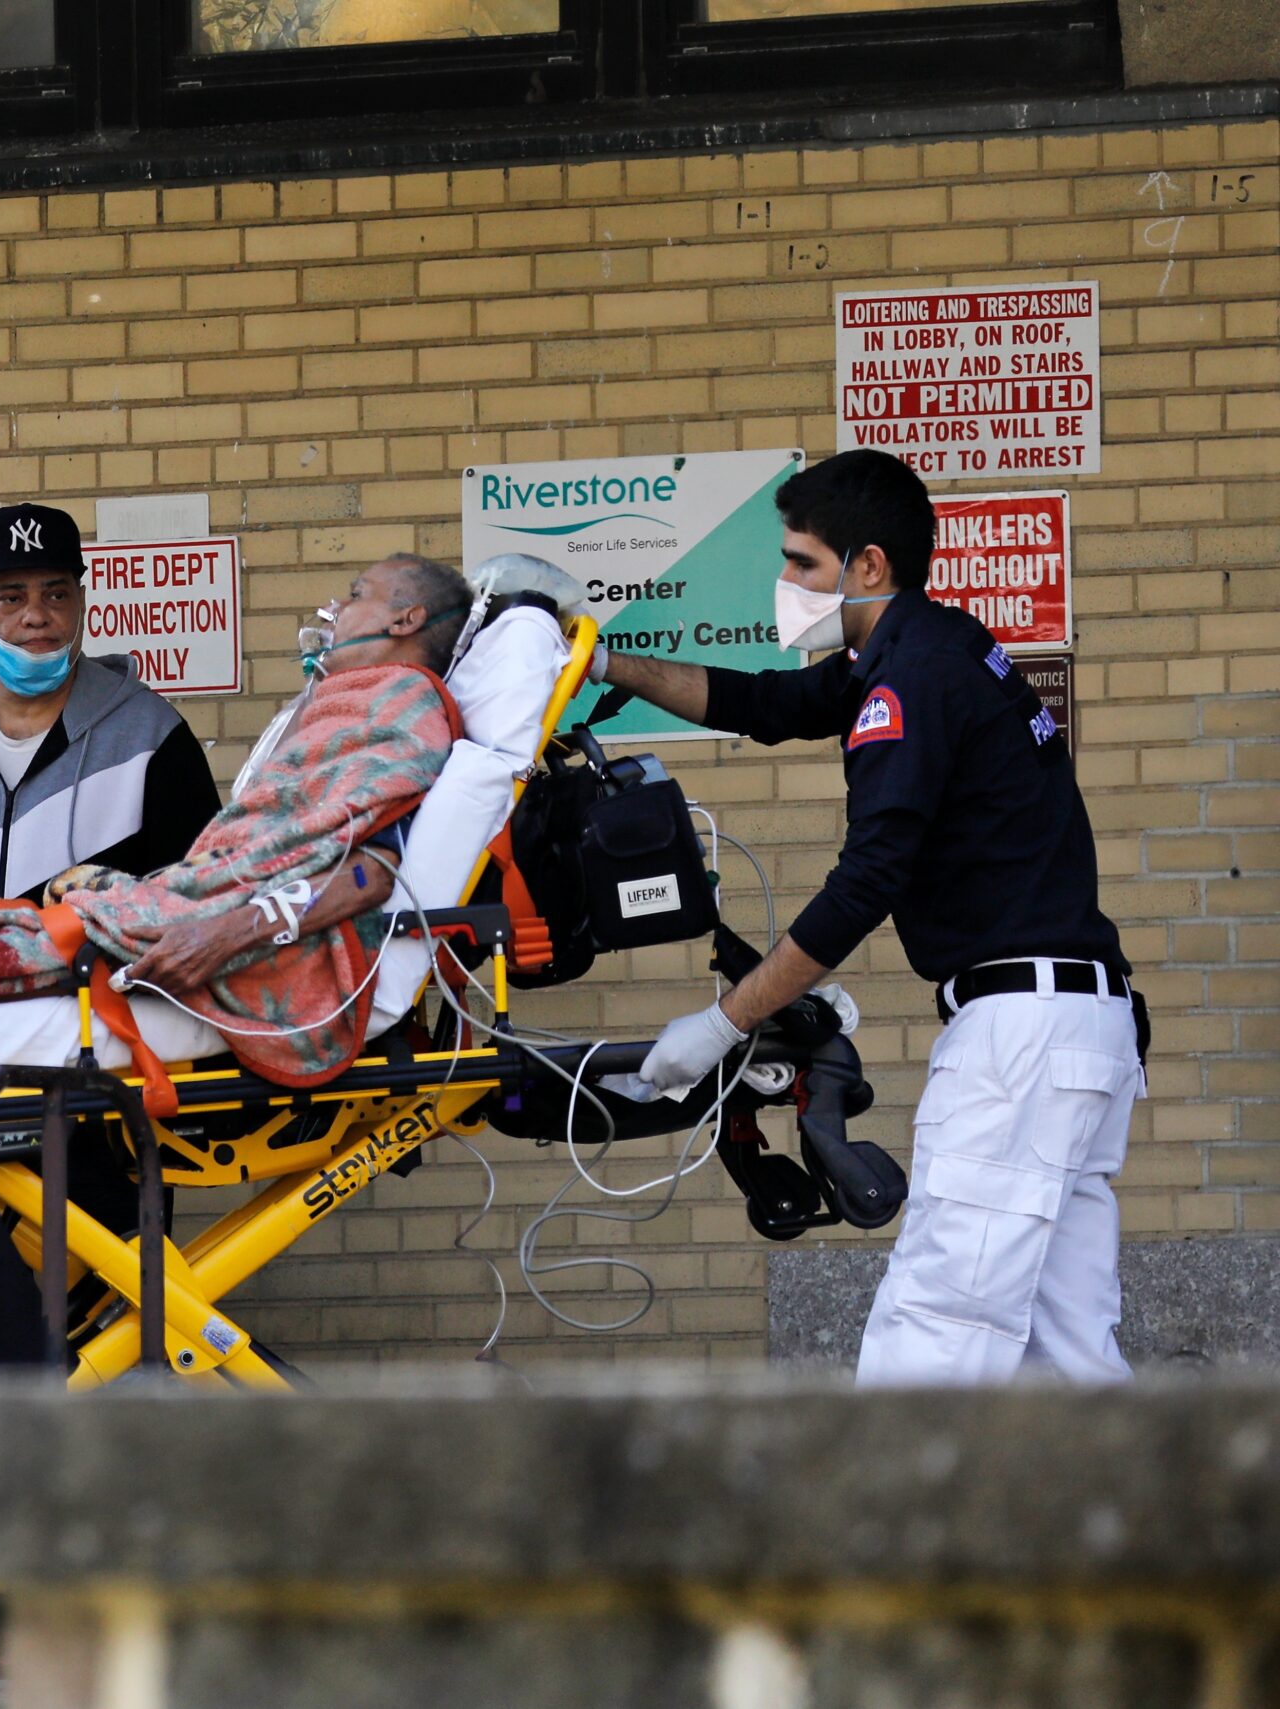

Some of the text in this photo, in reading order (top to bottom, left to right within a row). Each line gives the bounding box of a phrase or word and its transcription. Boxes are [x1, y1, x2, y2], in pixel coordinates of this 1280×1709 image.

[1211, 174, 1255, 203] 1-5
[736, 201, 771, 229] 1-1
[845, 292, 1090, 325] LOITERING AND TRESPASSING
[864, 322, 1071, 352] IN LOBBY, ON ROOF,
[852, 351, 1083, 382] HALLWAY AND STAIRS
[845, 378, 1091, 418] NOT PERMITTED
[854, 415, 1083, 446] VIOLATORS WILL BE
[958, 449, 986, 471] TO
[997, 445, 1085, 469] ARREST
[481, 474, 677, 511] Riverstone
[9, 517, 44, 552] NY
[567, 537, 678, 553] Senior Life Services
[933, 512, 1053, 549] INKLERS
[91, 552, 219, 590] FIRE DEPT
[924, 553, 1061, 591] OUGHOUT
[586, 577, 687, 602] Center
[87, 598, 227, 638] CONNECTION
[694, 621, 780, 646] Cente
[1027, 671, 1065, 687] NOTICE
[627, 886, 667, 903] LIFEPAK
